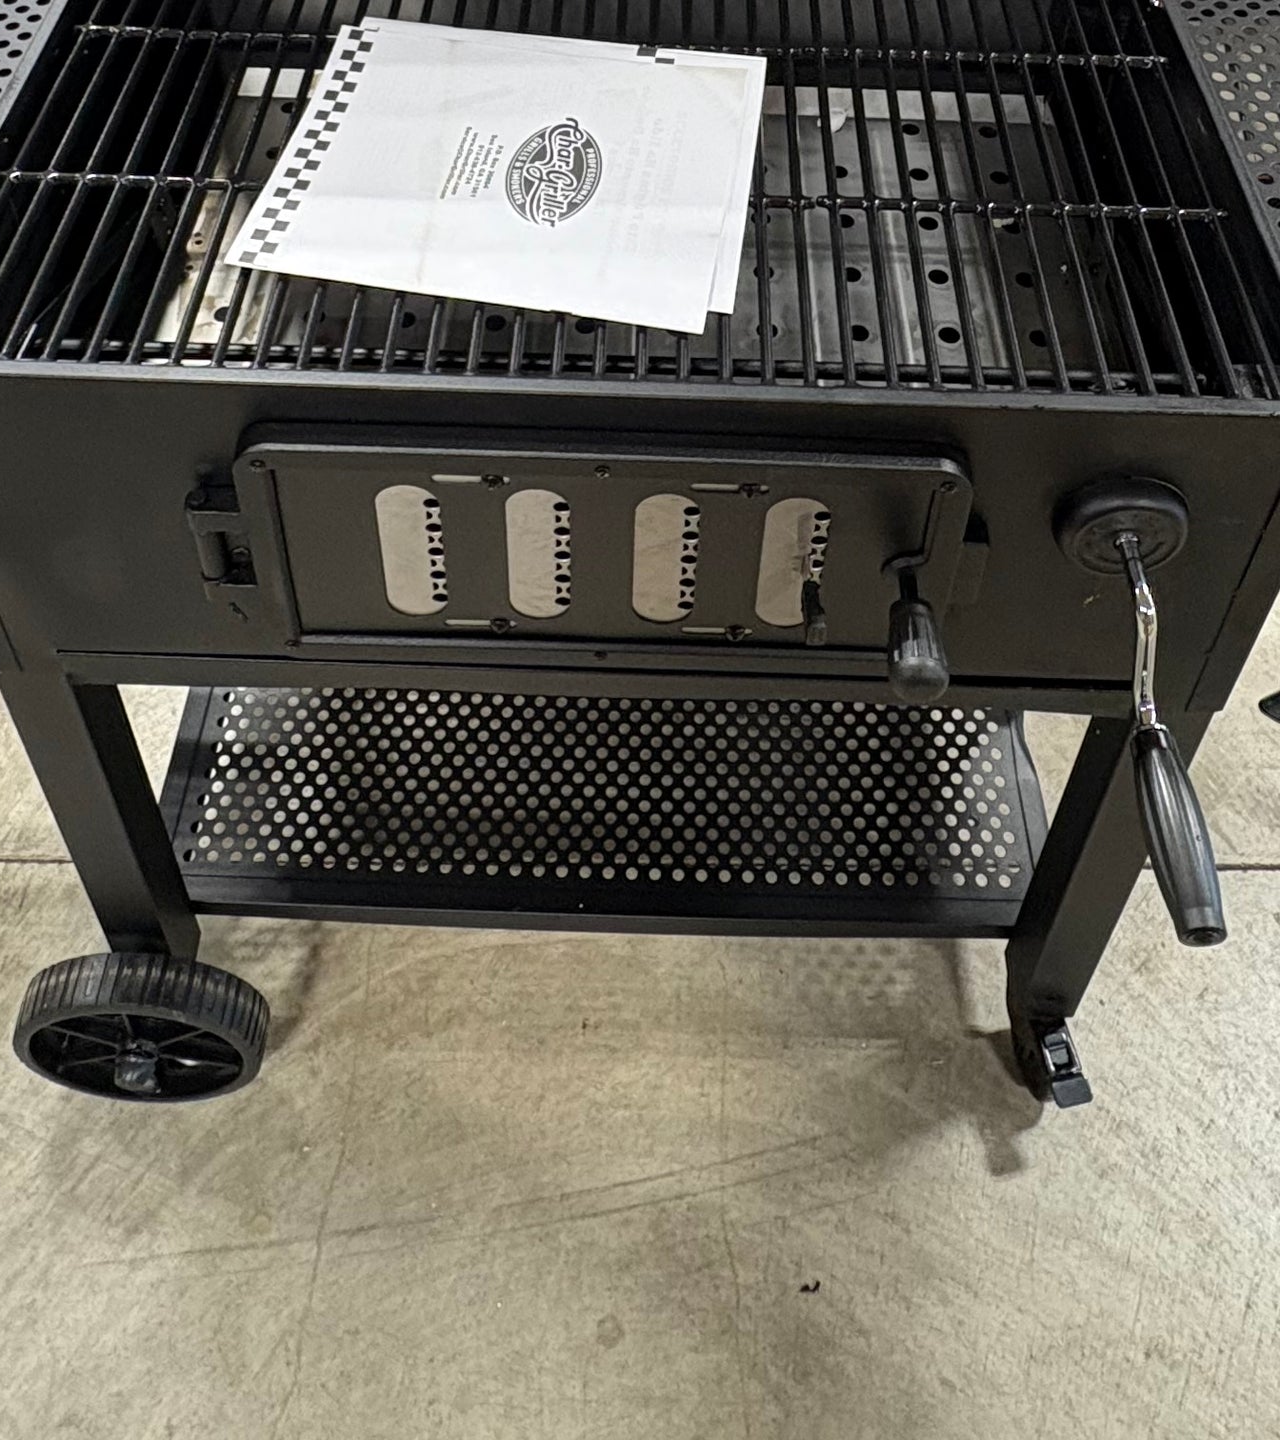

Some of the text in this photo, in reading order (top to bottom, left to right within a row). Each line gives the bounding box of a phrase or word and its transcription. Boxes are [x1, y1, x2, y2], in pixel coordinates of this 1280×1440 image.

[517, 136, 543, 162] GRILLS
[509, 168, 526, 205] SMOKERS
[571, 147, 598, 205] PROFESSIONAL
